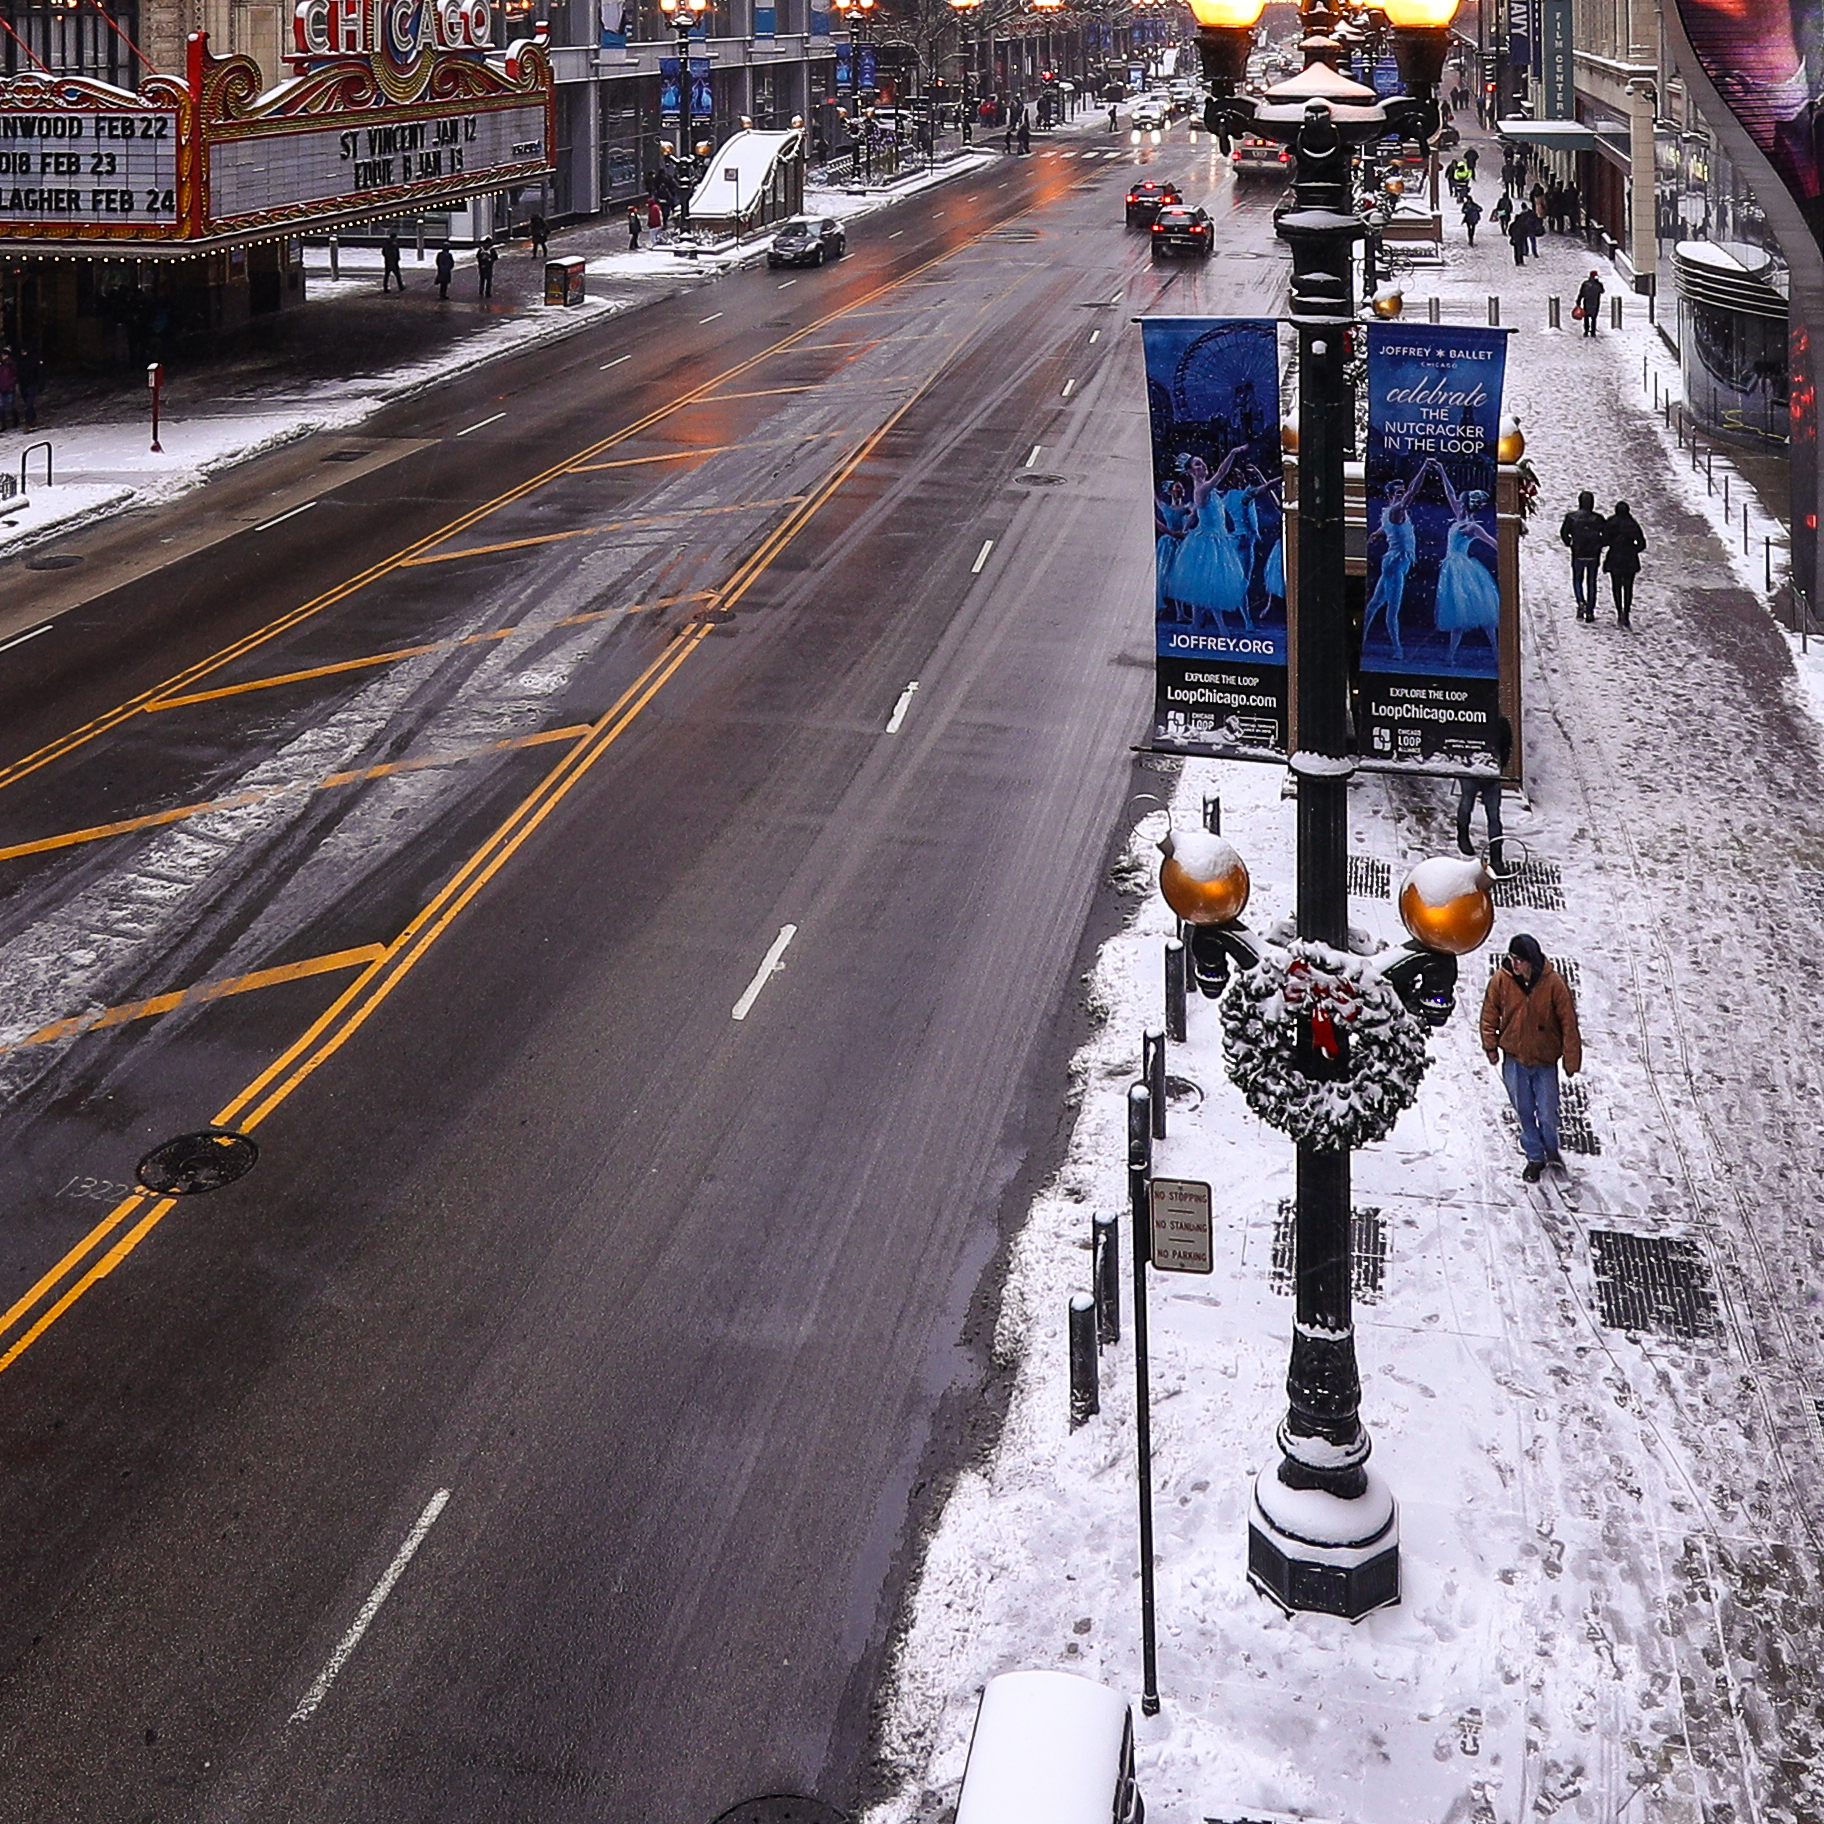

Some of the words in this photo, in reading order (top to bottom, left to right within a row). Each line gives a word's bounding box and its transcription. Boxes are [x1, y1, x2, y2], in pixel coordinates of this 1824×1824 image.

[1554, 11, 1564, 49] FILM
[1555, 55, 1565, 111] CENTER
[95, 116, 135, 139] FEB
[139, 116, 168, 139] 22
[340, 129, 359, 159] ST
[367, 121, 426, 156] VINCENT
[432, 117, 459, 146] JAN
[465, 114, 477, 141] 12
[40, 151, 81, 176] FEB
[90, 151, 117, 176] 23
[415, 148, 442, 177] JAN
[92, 189, 134, 213] FEB
[146, 189, 176, 213] 24
[1379, 345, 1432, 357] JOFFREY
[1449, 349, 1494, 360] BALLET
[1420, 361, 1458, 369] CHICAGO
[1386, 376, 1488, 408] celebrate
[1420, 407, 1450, 421] THE
[1385, 421, 1485, 438] NUTCRACKER
[1384, 436, 1400, 449] IN
[1405, 437, 1436, 452] THE
[1440, 439, 1485, 454] LOOP
[1169, 634, 1274, 655] JOFFREY.ORG
[1185, 672, 1221, 685] EXPLORE
[1221, 674, 1237, 686] THE
[1237, 676, 1260, 687] LOOP
[1167, 685, 1277, 708] LoopChicago.com
[1389, 687, 1427, 699] EXPLORE
[1428, 689, 1444, 701] THE
[1445, 691, 1469, 702] LOOP
[1371, 701, 1487, 724] LoopChicago.com
[1397, 735, 1422, 747] LOOP
[1154, 1190, 1165, 1200] NO
[1168, 1191, 1207, 1204] STOPPING
[1155, 1219, 1167, 1229] NO
[1169, 1220, 1207, 1233] STANDING
[1157, 1248, 1169, 1259] NO
[1172, 1249, 1207, 1262] PARKING
